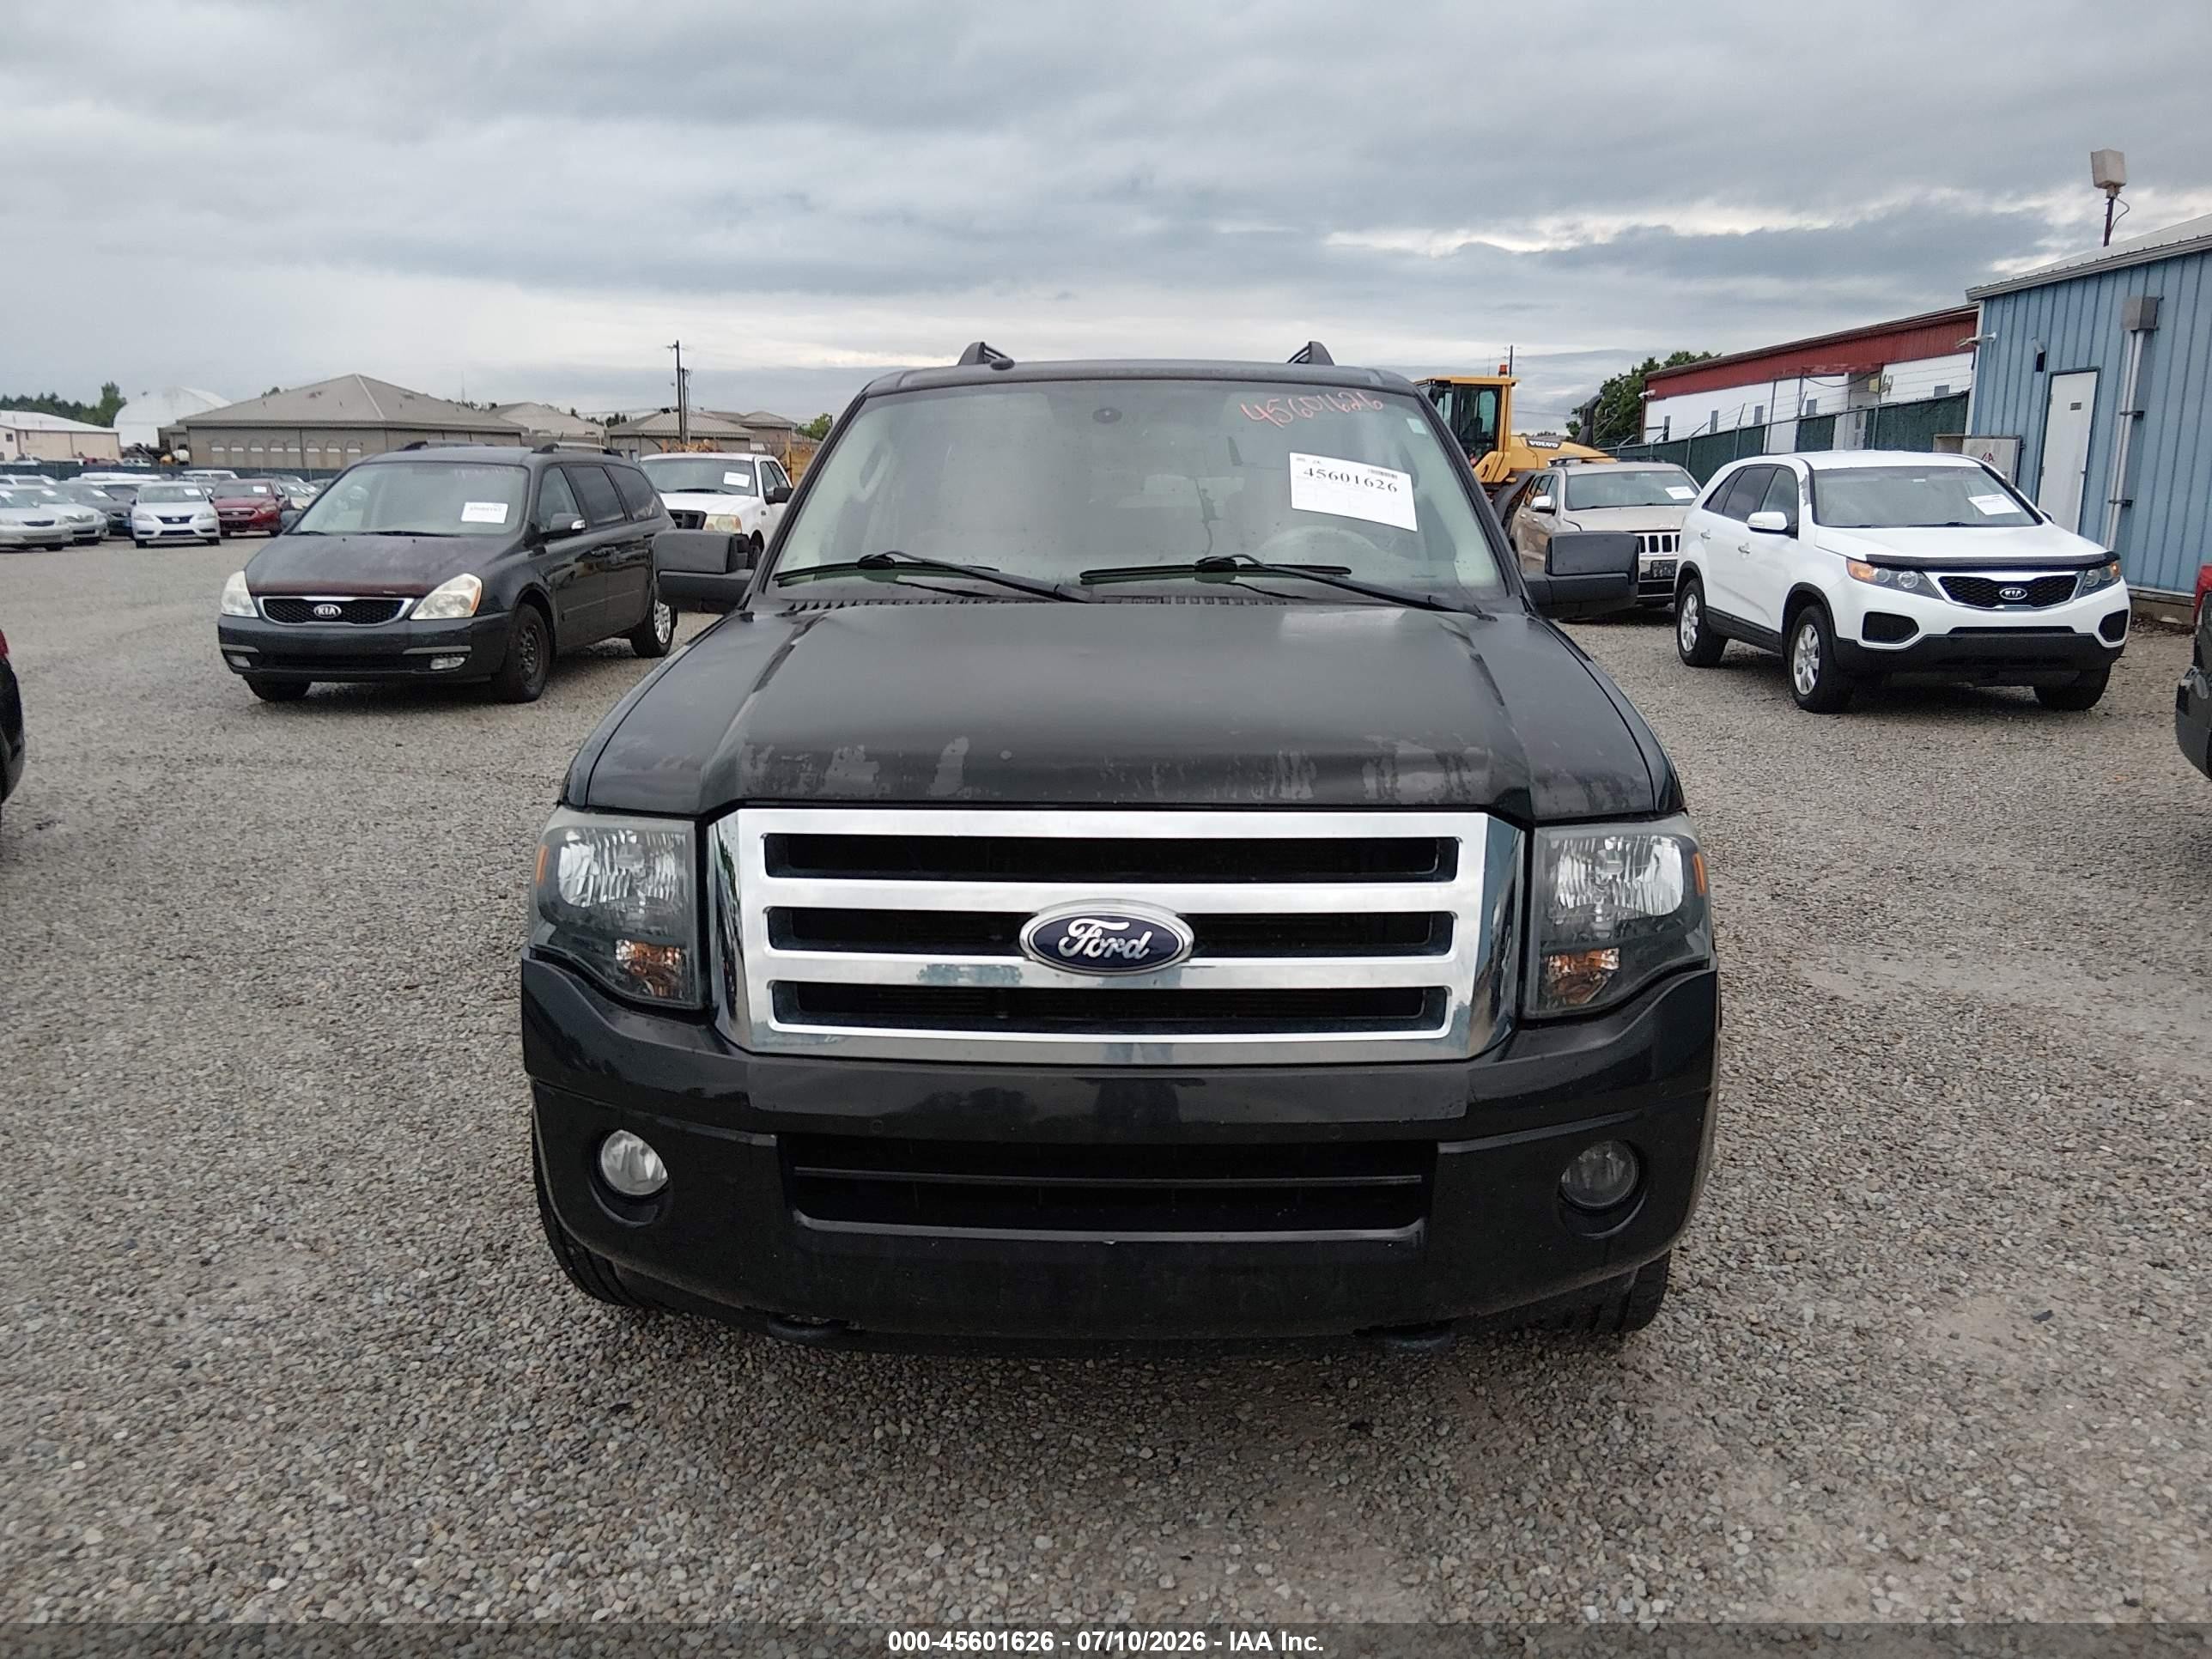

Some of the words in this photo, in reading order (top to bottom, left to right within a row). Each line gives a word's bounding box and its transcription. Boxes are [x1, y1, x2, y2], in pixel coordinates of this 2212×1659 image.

[1240, 391, 1384, 428] 45601626
[1528, 440, 1559, 448] VOLVO
[1304, 467, 1398, 493] 45601626
[1057, 918, 1153, 960] Ford
